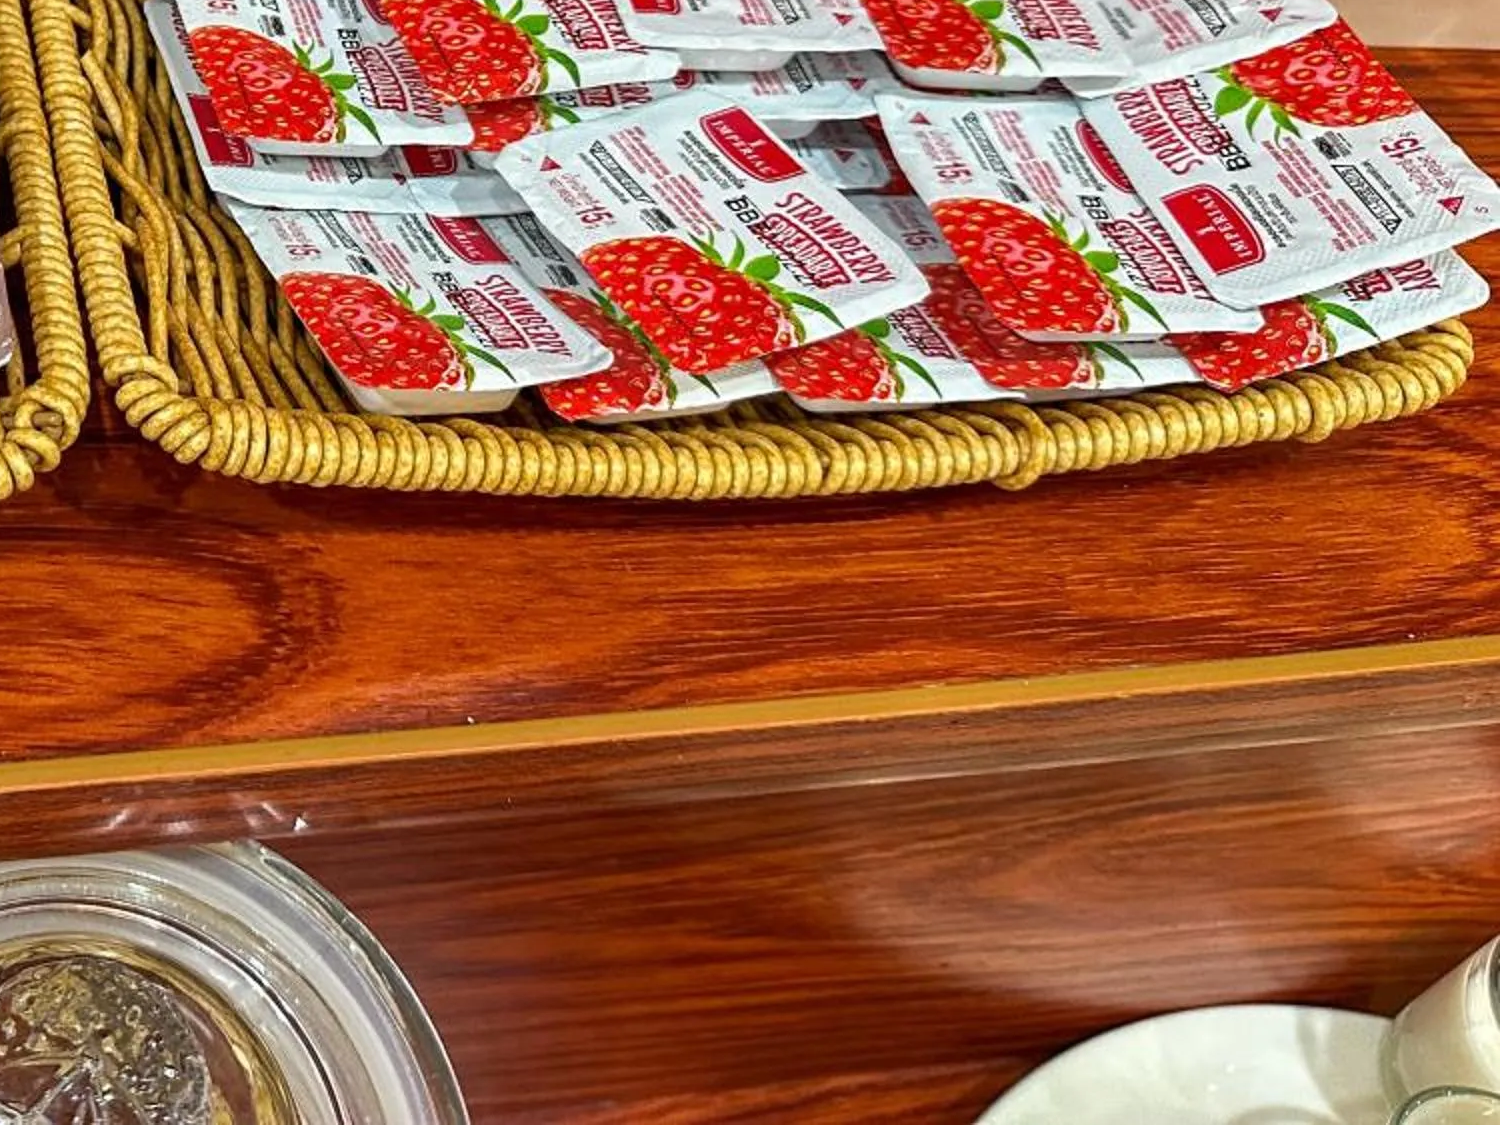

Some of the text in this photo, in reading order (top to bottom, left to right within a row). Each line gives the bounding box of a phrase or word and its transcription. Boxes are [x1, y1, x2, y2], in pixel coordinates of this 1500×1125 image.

[712, 120, 779, 179] IMPERIAL
[935, 162, 972, 185] 15
[1380, 129, 1421, 160] 15
[576, 204, 613, 227] 15
[775, 192, 898, 285] STRAWBERRY
[902, 227, 938, 252] 15
[1198, 193, 1252, 259] IMPERIAL
[287, 243, 321, 260] 15
[762, 213, 851, 289] SPREADABLE
[1112, 218, 1185, 296] SPREADABLE
[474, 275, 572, 357] STRAWBERRY
